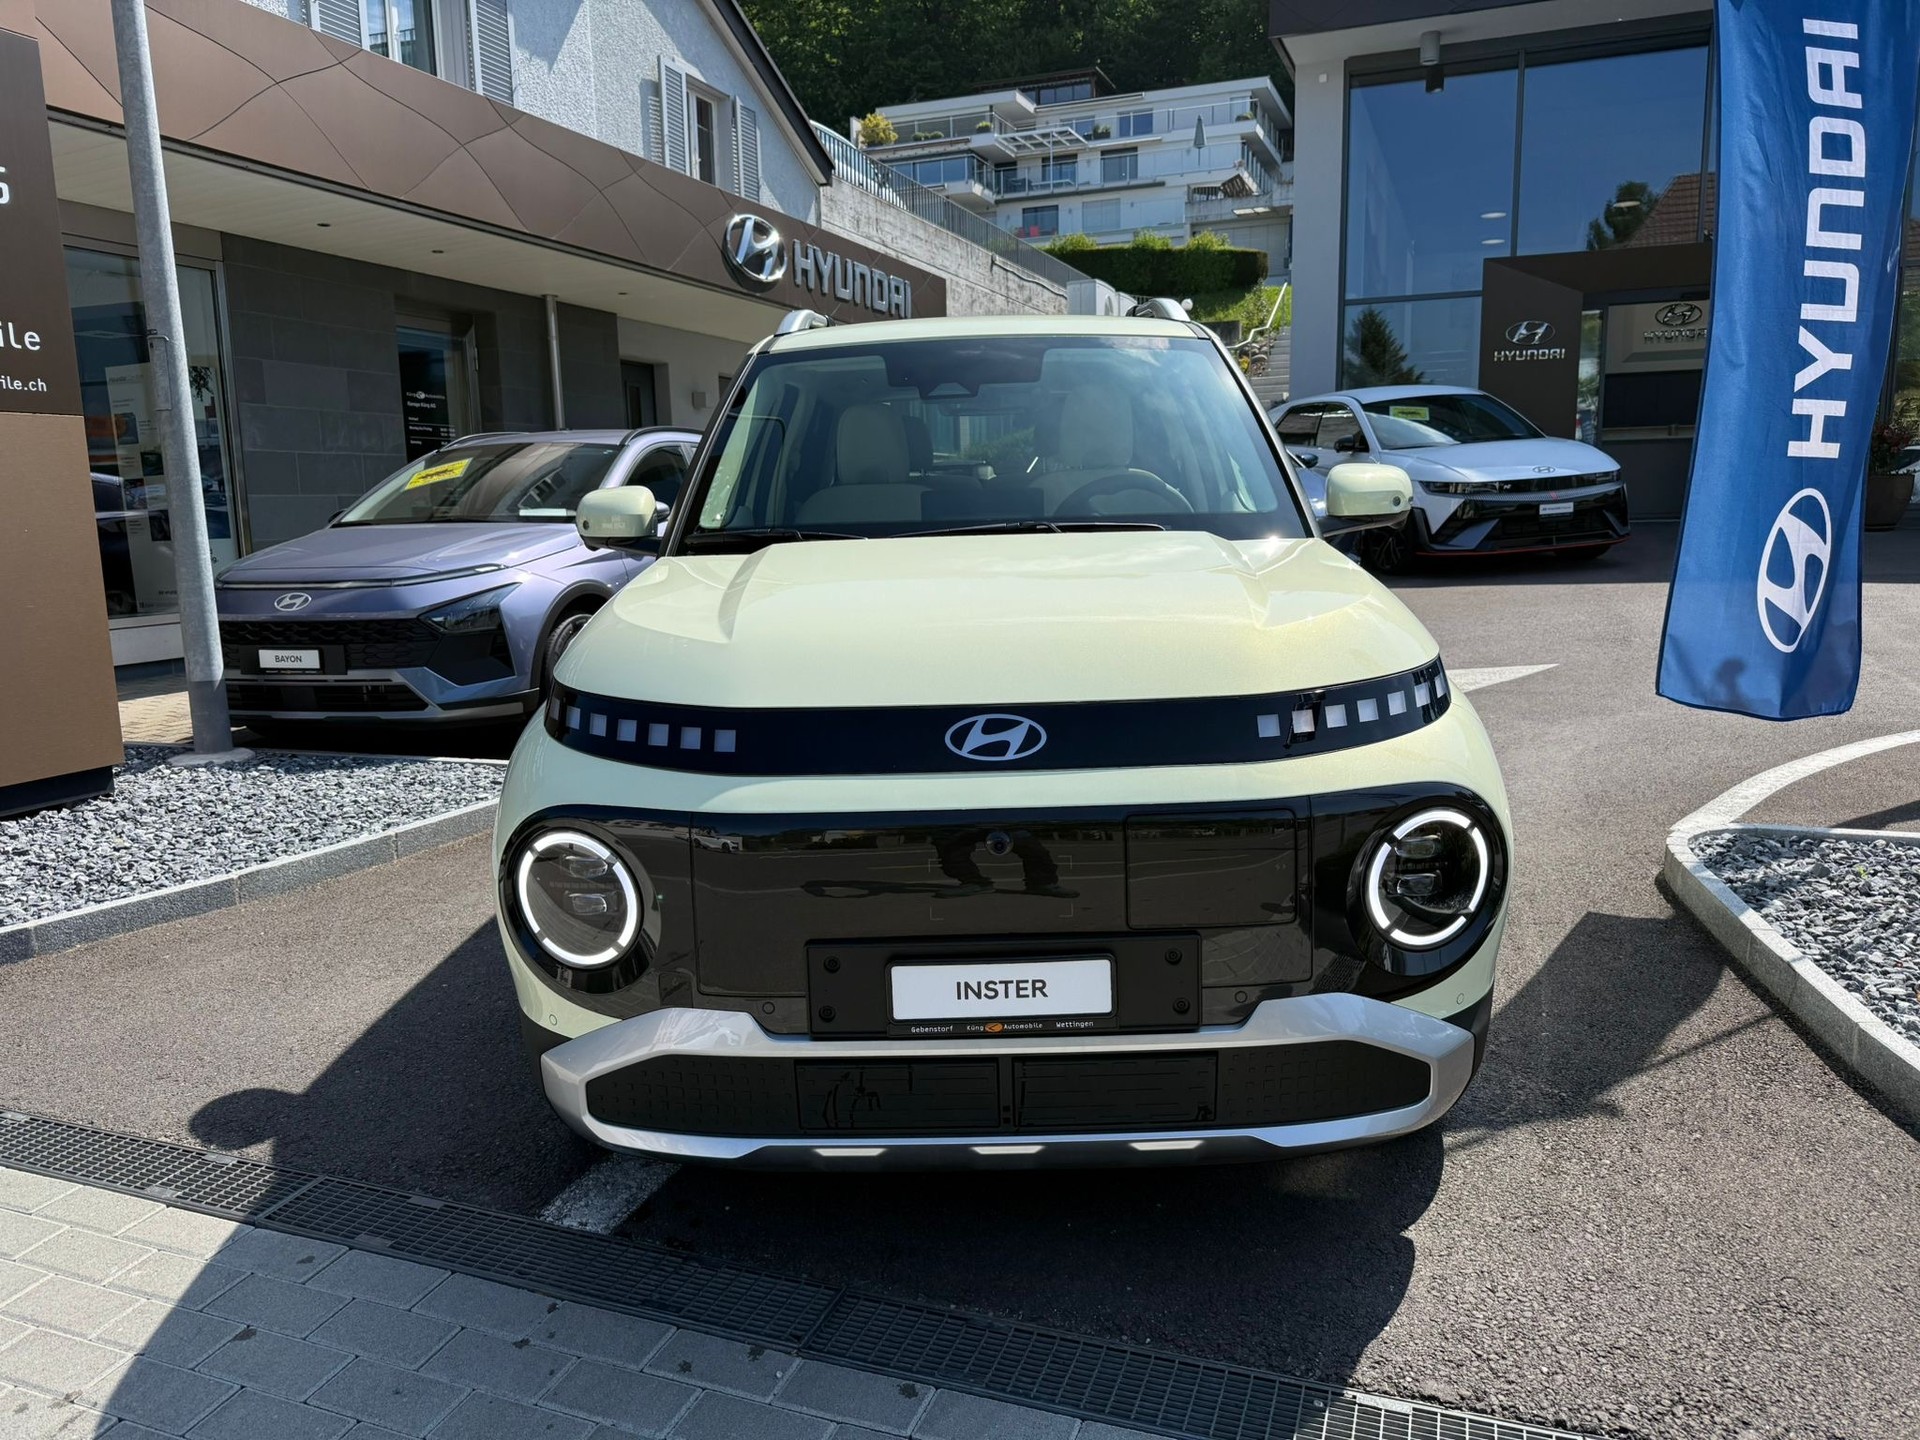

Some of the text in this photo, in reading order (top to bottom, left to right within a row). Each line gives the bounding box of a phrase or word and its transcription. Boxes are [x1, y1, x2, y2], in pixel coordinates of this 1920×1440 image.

[1786, 18, 1867, 459] HYUNDAI
[792, 238, 912, 319] HYUNDAI
[1493, 348, 1566, 362] HYUNDAI
[274, 655, 303, 663] BAYON
[956, 978, 1049, 1001] INSTER
[910, 1025, 953, 1033] Gebenstorf
[1003, 1022, 1043, 1030] Automobile
[1055, 1020, 1094, 1029] Wettingen
